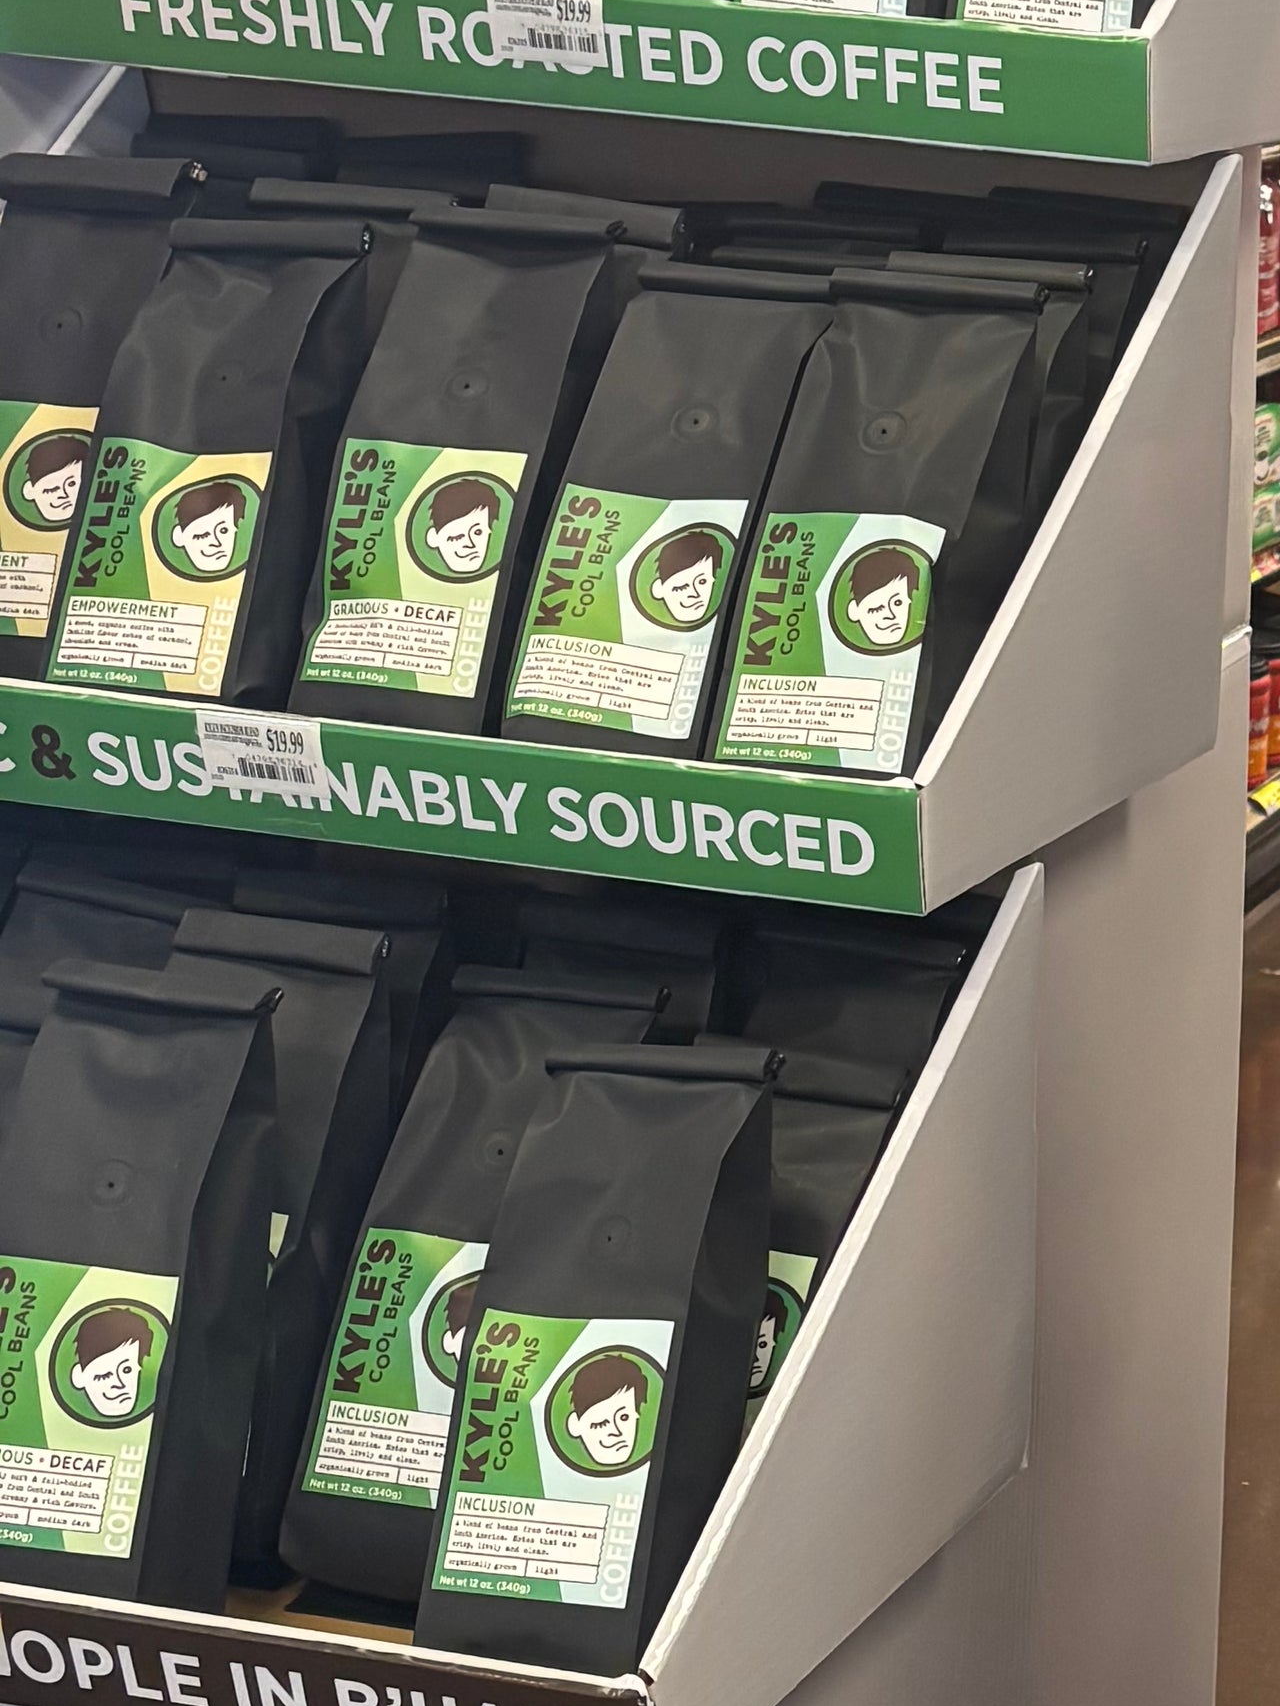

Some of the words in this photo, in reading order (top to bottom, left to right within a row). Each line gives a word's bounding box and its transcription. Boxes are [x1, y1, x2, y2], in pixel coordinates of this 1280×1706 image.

[416, 4, 724, 88] ROTED
[746, 36, 1005, 115] COFFEE
[74, 445, 129, 589] KYLE'S
[104, 524, 130, 577] COOL
[118, 458, 147, 520] BEANS
[330, 448, 380, 591] KYLE'S
[356, 527, 384, 578] COOL
[370, 458, 397, 521] BEANS
[532, 494, 603, 629] KYLE'S
[571, 570, 604, 618] COOL
[588, 509, 621, 566] BEANS
[791, 529, 815, 596] BEANS
[71, 600, 178, 618] EMPOWERMENT
[333, 602, 389, 616] GRACIOUS
[404, 605, 456, 622] DECAF
[743, 520, 799, 666] KYLE'S
[779, 601, 808, 656] COOL
[198, 595, 237, 690] COFFEE
[452, 597, 490, 694] COFFEE
[532, 637, 613, 657] INCLUSION
[669, 641, 707, 737] COFFEE
[743, 678, 817, 692] INCLUSION
[265, 727, 305, 756] $19.99
[875, 668, 914, 770] COFFEE
[30, 723, 78, 782] &
[87, 730, 533, 838] SUSNABLY
[547, 790, 877, 878] SOURCED
[8, 1280, 37, 1354] BEANS
[332, 1238, 397, 1394] KYLE'S
[369, 1327, 397, 1384] COOL
[385, 1251, 414, 1322] BEANS
[331, 1404, 409, 1427] INCLUSION
[459, 1321, 522, 1483] KYLE'S
[506, 1335, 541, 1406] BEANS
[50, 1455, 106, 1473] DECAF
[492, 1410, 521, 1471] COOL
[104, 1444, 143, 1551] COFFEE
[458, 1497, 535, 1516] INCLUSION
[440, 1575, 455, 1586] Net
[457, 1576, 467, 1586] wt
[470, 1577, 477, 1588] 12
[480, 1580, 494, 1589] oz.
[496, 1581, 531, 1594] (340g)
[599, 1491, 641, 1604] COFFEE
